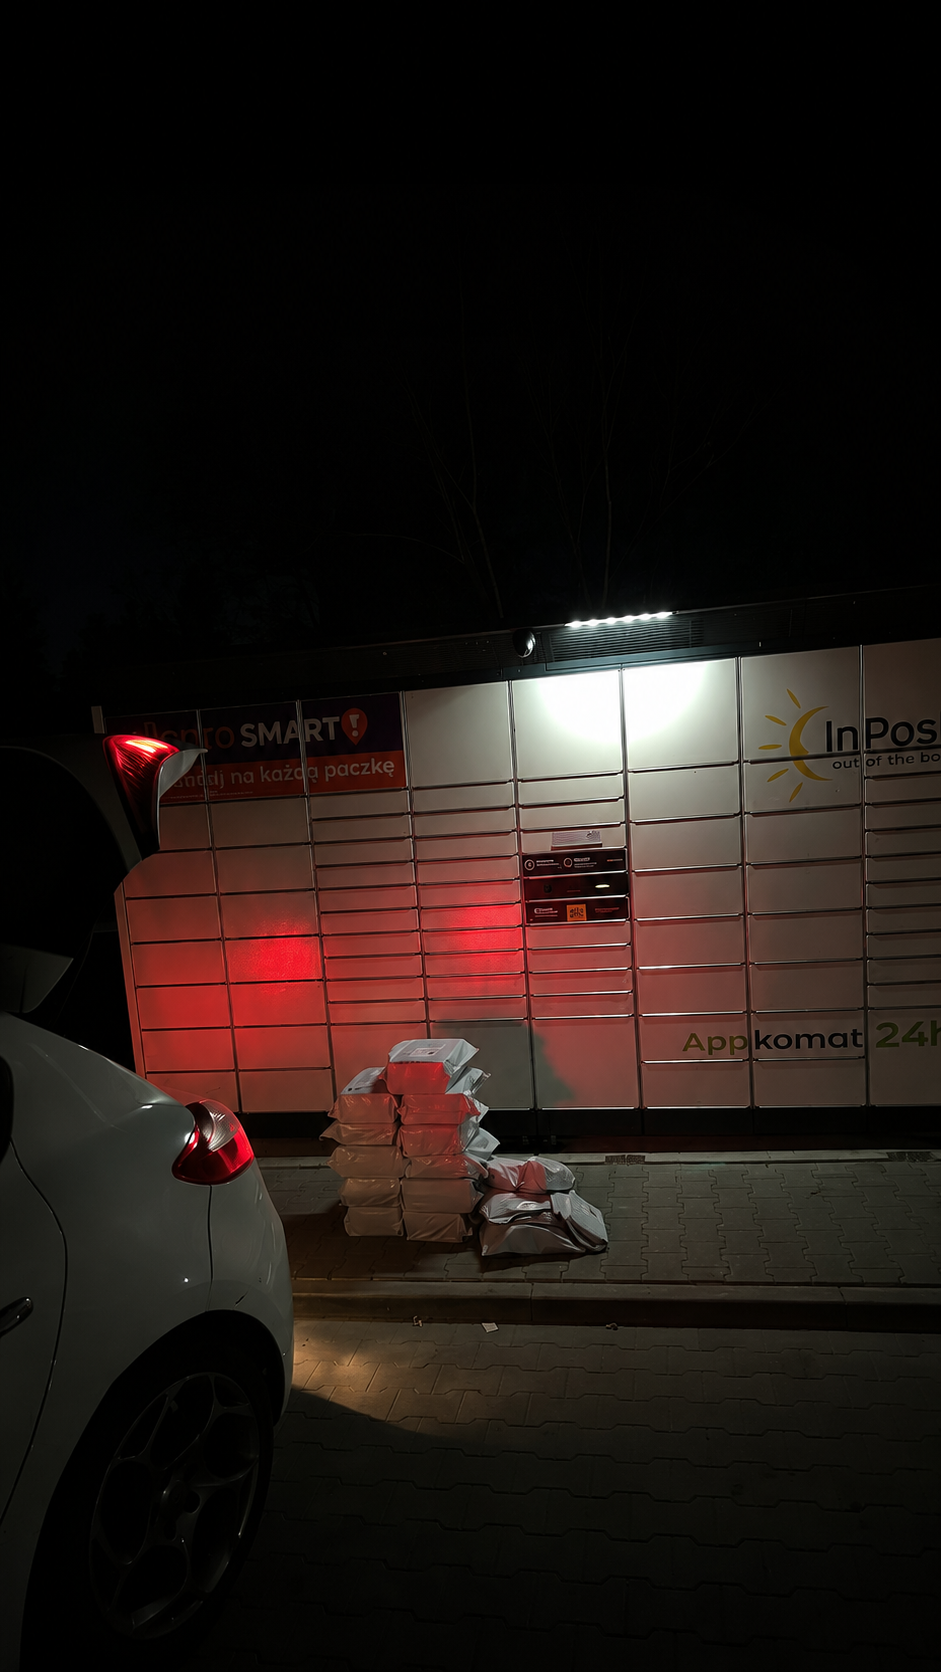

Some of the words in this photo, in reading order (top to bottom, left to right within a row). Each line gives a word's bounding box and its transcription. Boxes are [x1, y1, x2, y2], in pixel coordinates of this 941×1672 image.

[826, 717, 941, 752] InPos
[230, 770, 255, 786] na
[260, 763, 319, 784] każdą
[324, 757, 395, 782] paczkę
[832, 758, 859, 769] out
[866, 755, 882, 767] of
[888, 754, 914, 766] the
[920, 752, 941, 763] bo
